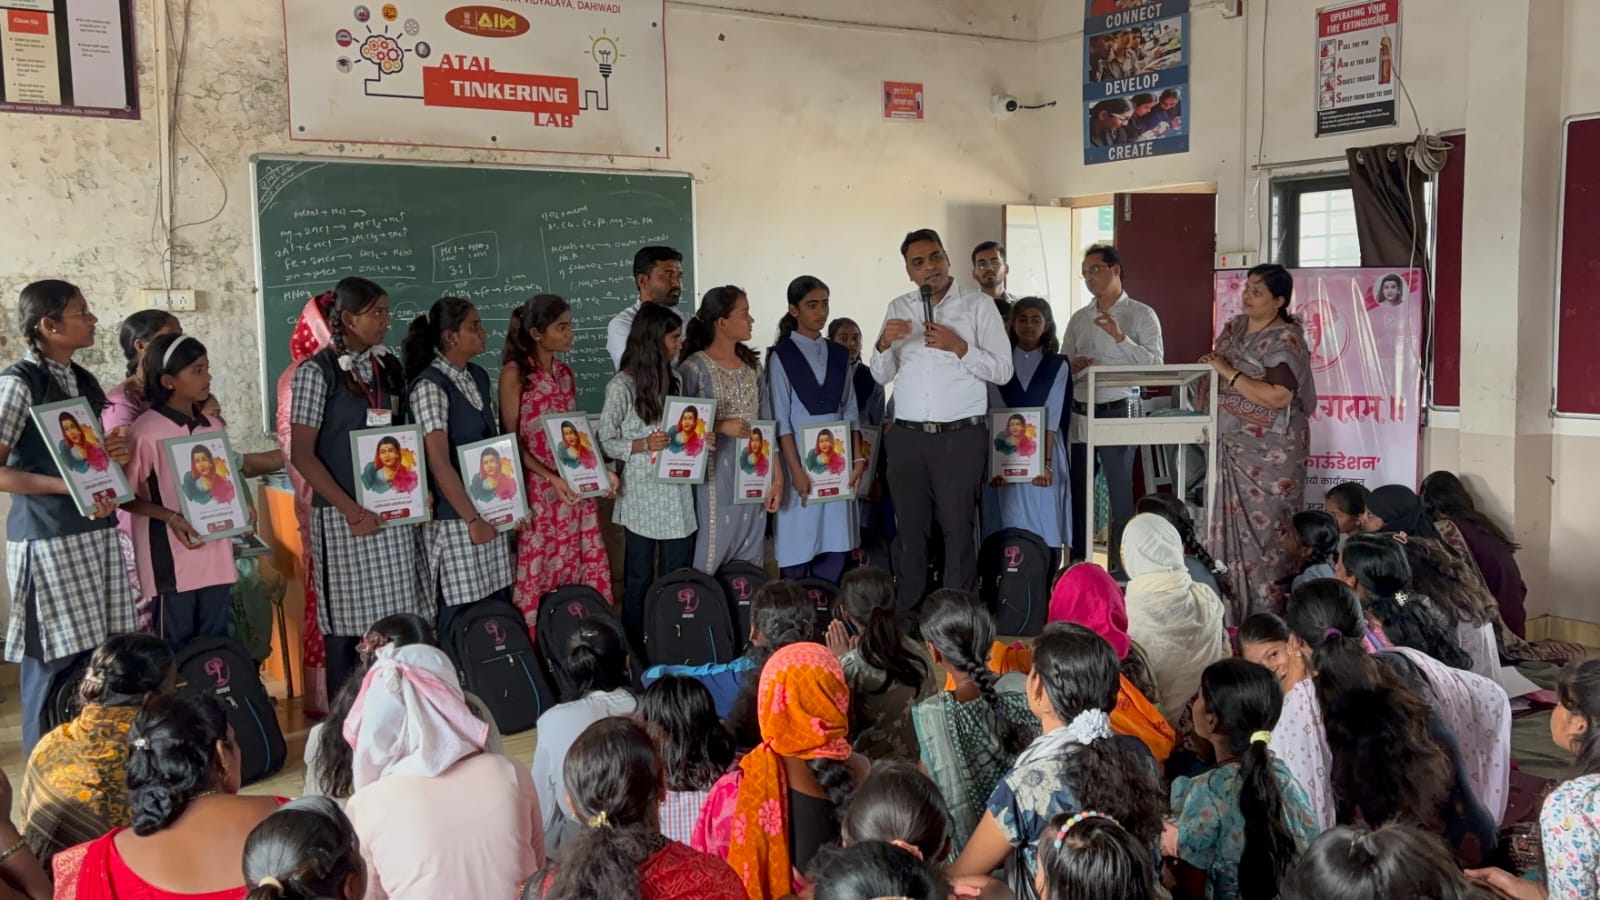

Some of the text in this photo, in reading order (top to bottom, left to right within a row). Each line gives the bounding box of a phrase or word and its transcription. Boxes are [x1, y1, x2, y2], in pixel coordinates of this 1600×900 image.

[577, 1, 621, 14] DAHIWADI
[1106, 4, 1162, 29] CONNECT
[1330, 3, 1387, 23] OPERATING YOUR
[1327, 14, 1389, 34] FIRE EXTINGUISHER
[440, 53, 495, 72] ATAL
[450, 80, 568, 104] TINKERING
[1106, 73, 1159, 96] DEVELOP
[534, 112, 573, 128] LAB
[1108, 142, 1153, 161] CREATE
